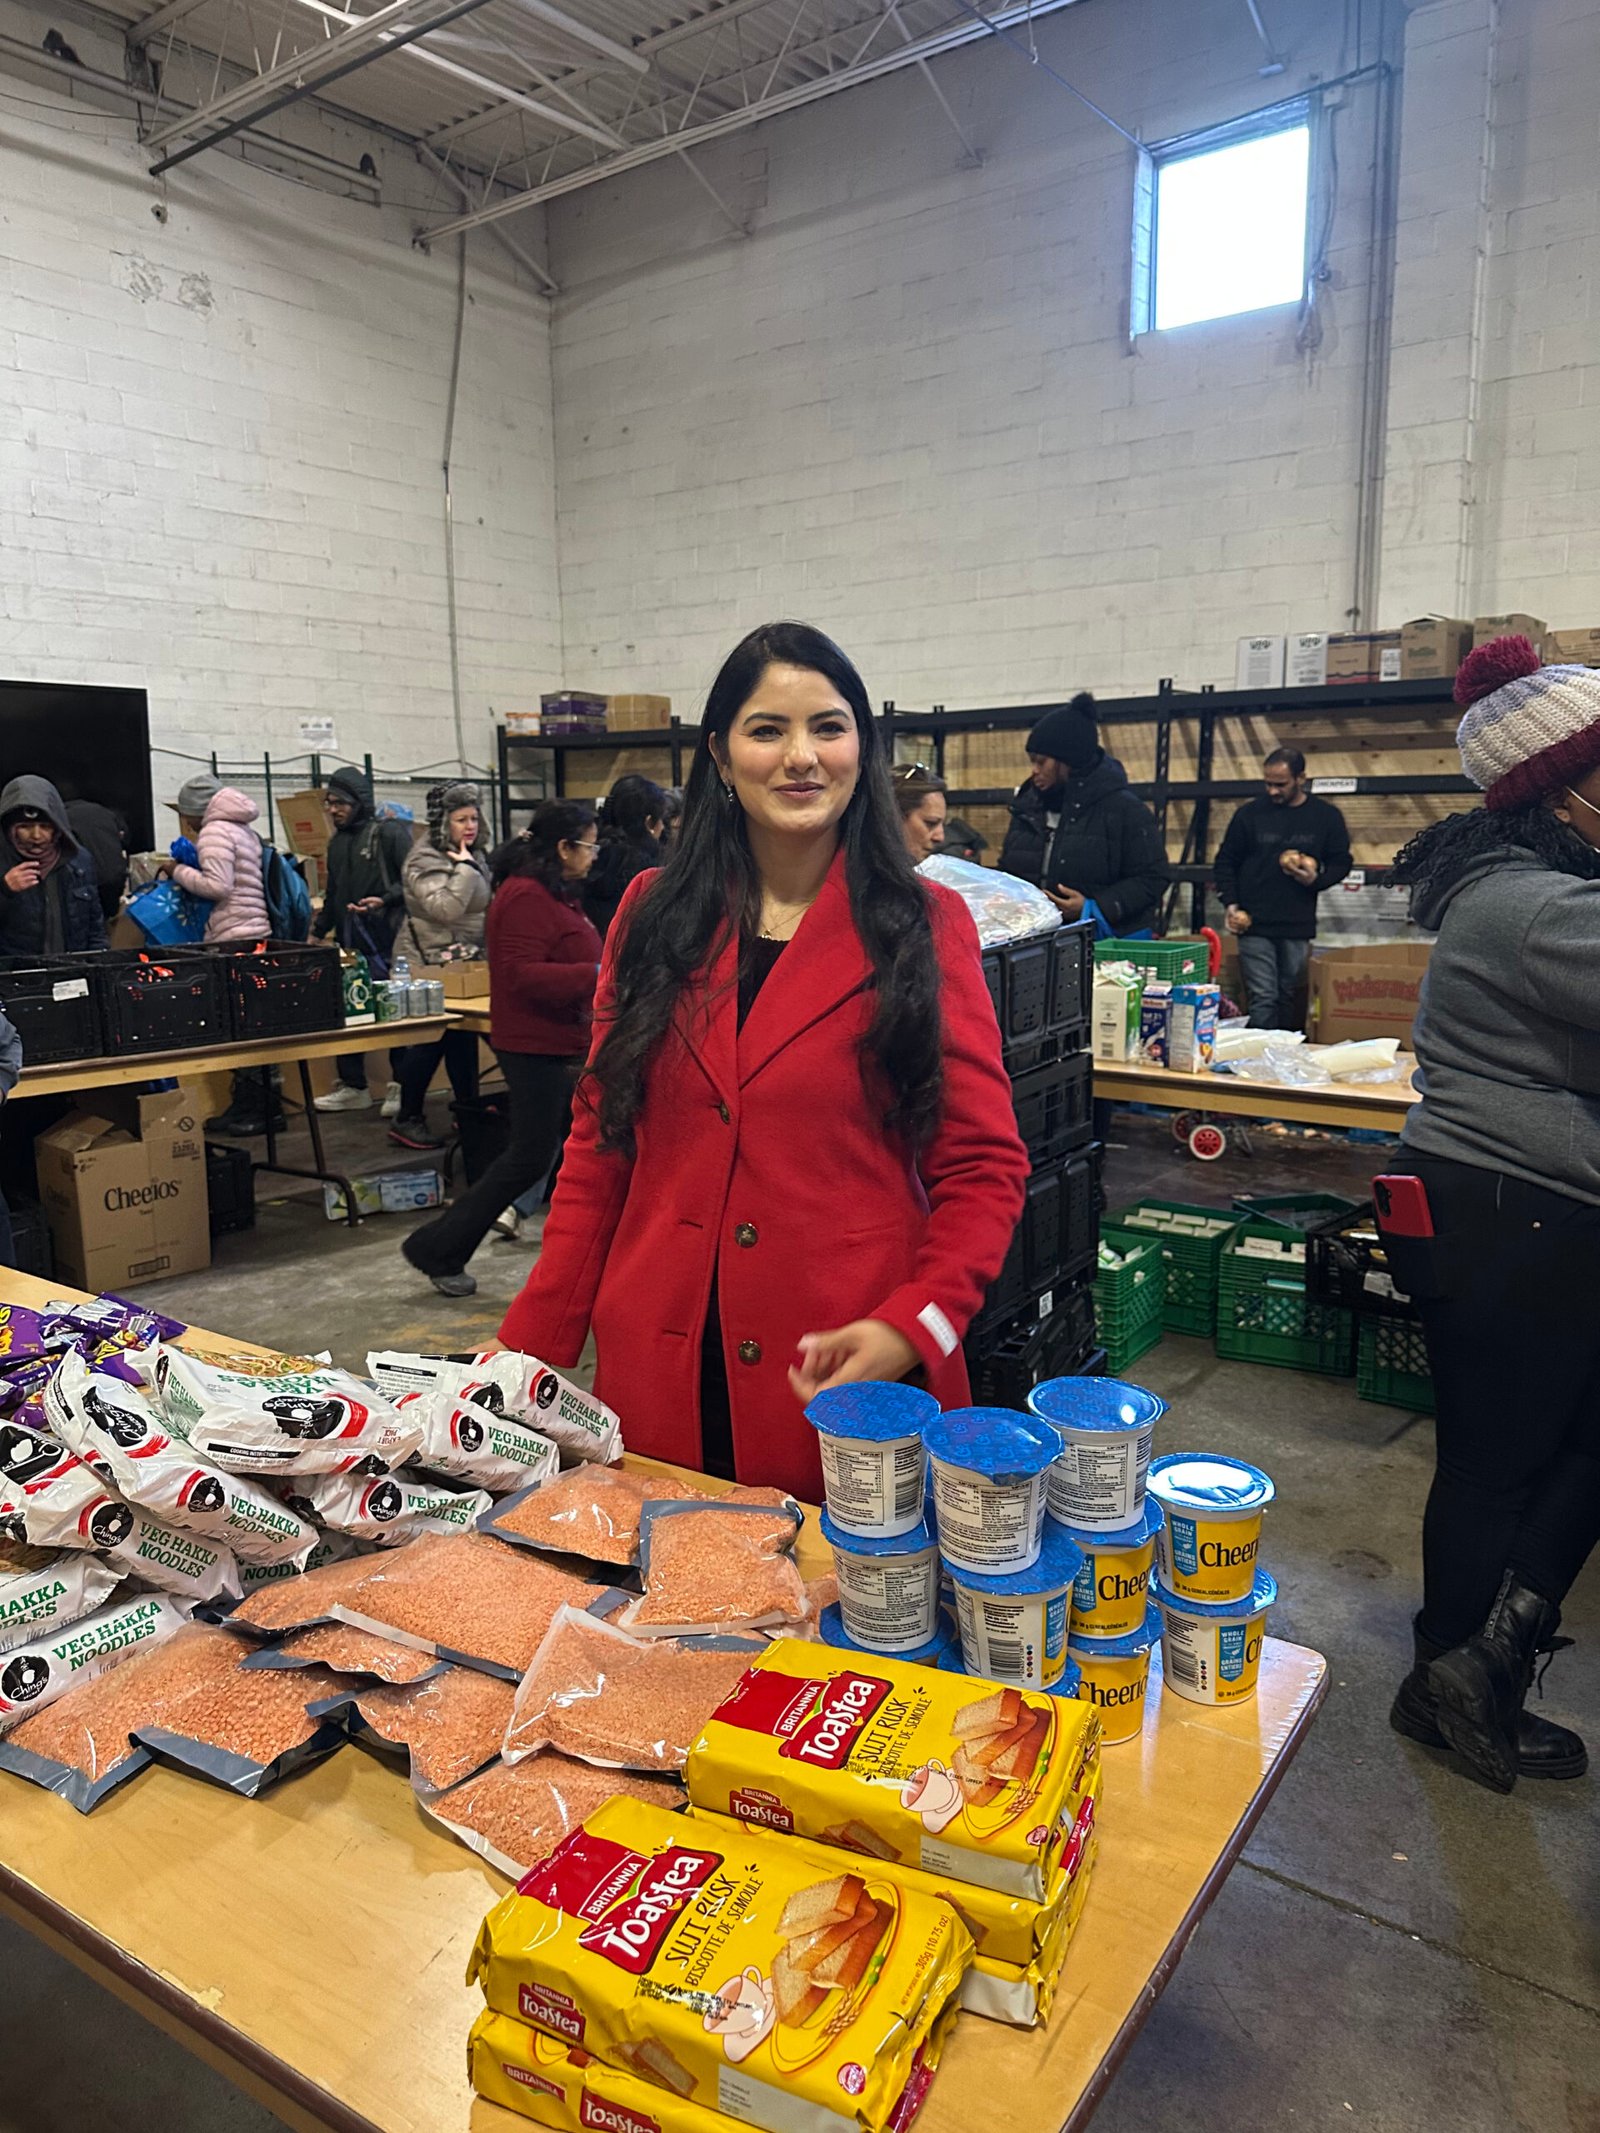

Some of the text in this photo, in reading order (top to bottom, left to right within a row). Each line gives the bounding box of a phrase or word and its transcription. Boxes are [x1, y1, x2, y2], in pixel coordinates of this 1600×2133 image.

[104, 1179, 180, 1212] Cheeios
[103, 1403, 142, 1440] Ching's
[264, 1400, 330, 1411] Ching's
[559, 1404, 602, 1438] NOODLES
[561, 1389, 610, 1428] VEG HAKKA
[488, 1426, 548, 1457] VEG HAKKA
[492, 1442, 540, 1467] NOODLES
[231, 1494, 256, 1518] VEG
[256, 1507, 300, 1538] HAKKA
[370, 1503, 397, 1517] Ching's
[407, 1494, 436, 1509] VEG
[92, 1525, 121, 1543] Ching's
[1172, 1520, 1194, 1532] WHOLE
[1174, 1526, 1192, 1536] GRAIN
[136, 1541, 206, 1578] NOODLES
[139, 1521, 218, 1567] VEG HAKKA
[52, 1600, 162, 1661] VEG HAKKA
[69, 1619, 156, 1671] NOODLES
[1221, 1630, 1244, 1638] WHOLE
[11, 1676, 48, 1699] Ching's
[780, 1686, 821, 1732] BRITANNIA
[800, 1680, 876, 1760] Toastea
[857, 1697, 912, 1763] SUJI RUSK
[879, 1698, 932, 1775] BISCOTTE DE SEMOULE
[733, 1799, 789, 1827] Toastea
[744, 1789, 778, 1804] BRITANNIA
[587, 1862, 642, 1915] BRITANNIA
[602, 1856, 704, 1959] Toastea
[665, 1873, 740, 1969] SUJI RUSK
[685, 1877, 763, 1986] BISCOTTE DE SEMOULE
[534, 1985, 570, 2006] BRITANNIA
[522, 1993, 580, 2036] Toastea
[507, 2067, 559, 2097] BRITANNIA
